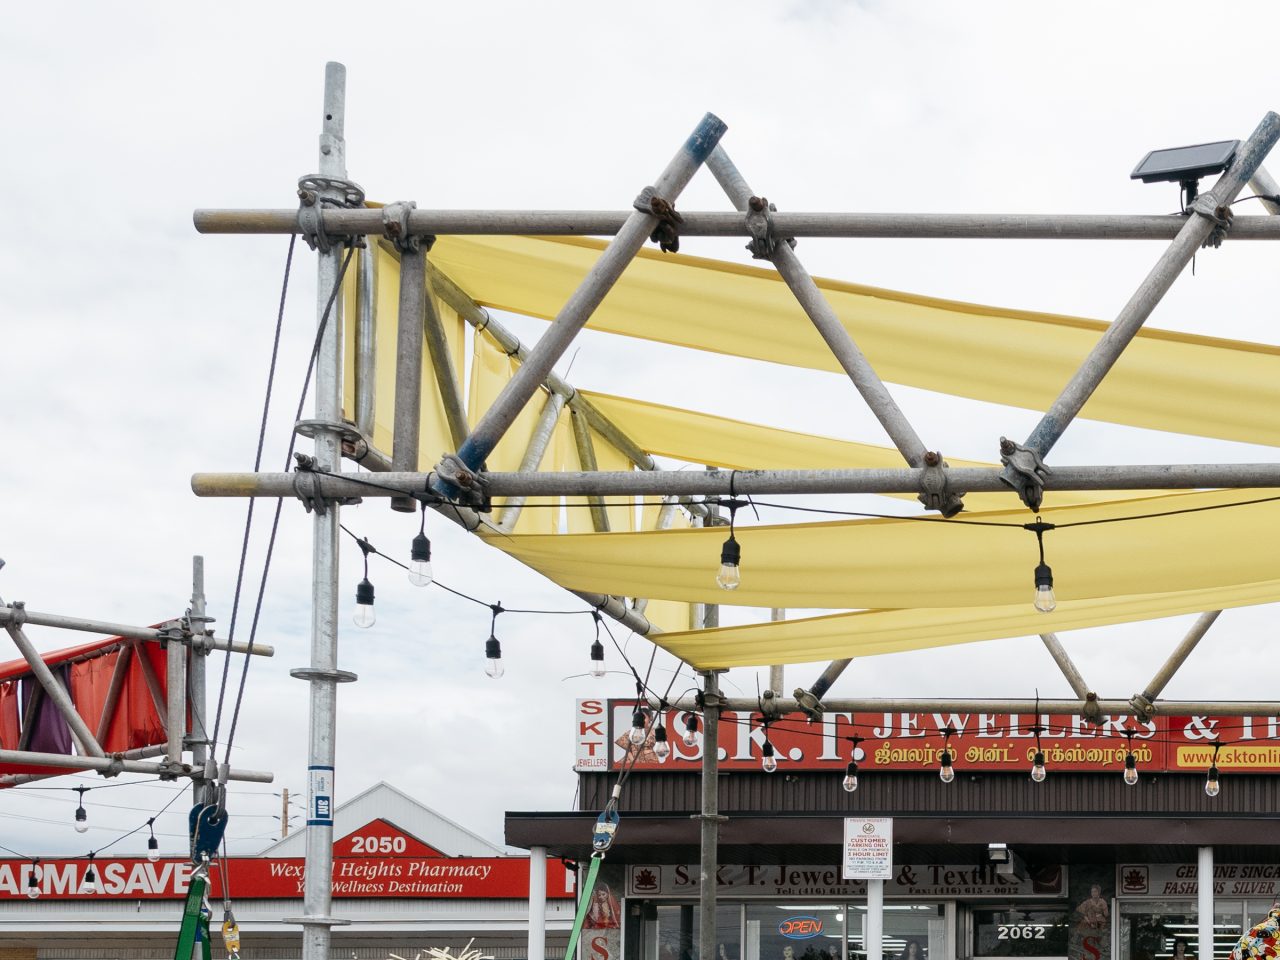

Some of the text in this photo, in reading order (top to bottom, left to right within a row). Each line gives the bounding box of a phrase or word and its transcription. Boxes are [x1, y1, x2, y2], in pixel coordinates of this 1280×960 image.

[1183, 715, 1220, 740] &
[577, 759, 607, 768] JEWELLERS
[351, 836, 406, 854] 2050
[270, 861, 491, 880] Wexf Heights Pharmacy
[896, 865, 918, 887] &
[1176, 866, 1236, 879] GEINE
[331, 880, 463, 894] Wellness Destination
[1163, 881, 1225, 895] FASHNS
[1232, 881, 1275, 895] SILVER
[780, 919, 822, 934] OPEN
[997, 926, 1046, 940] 2062
